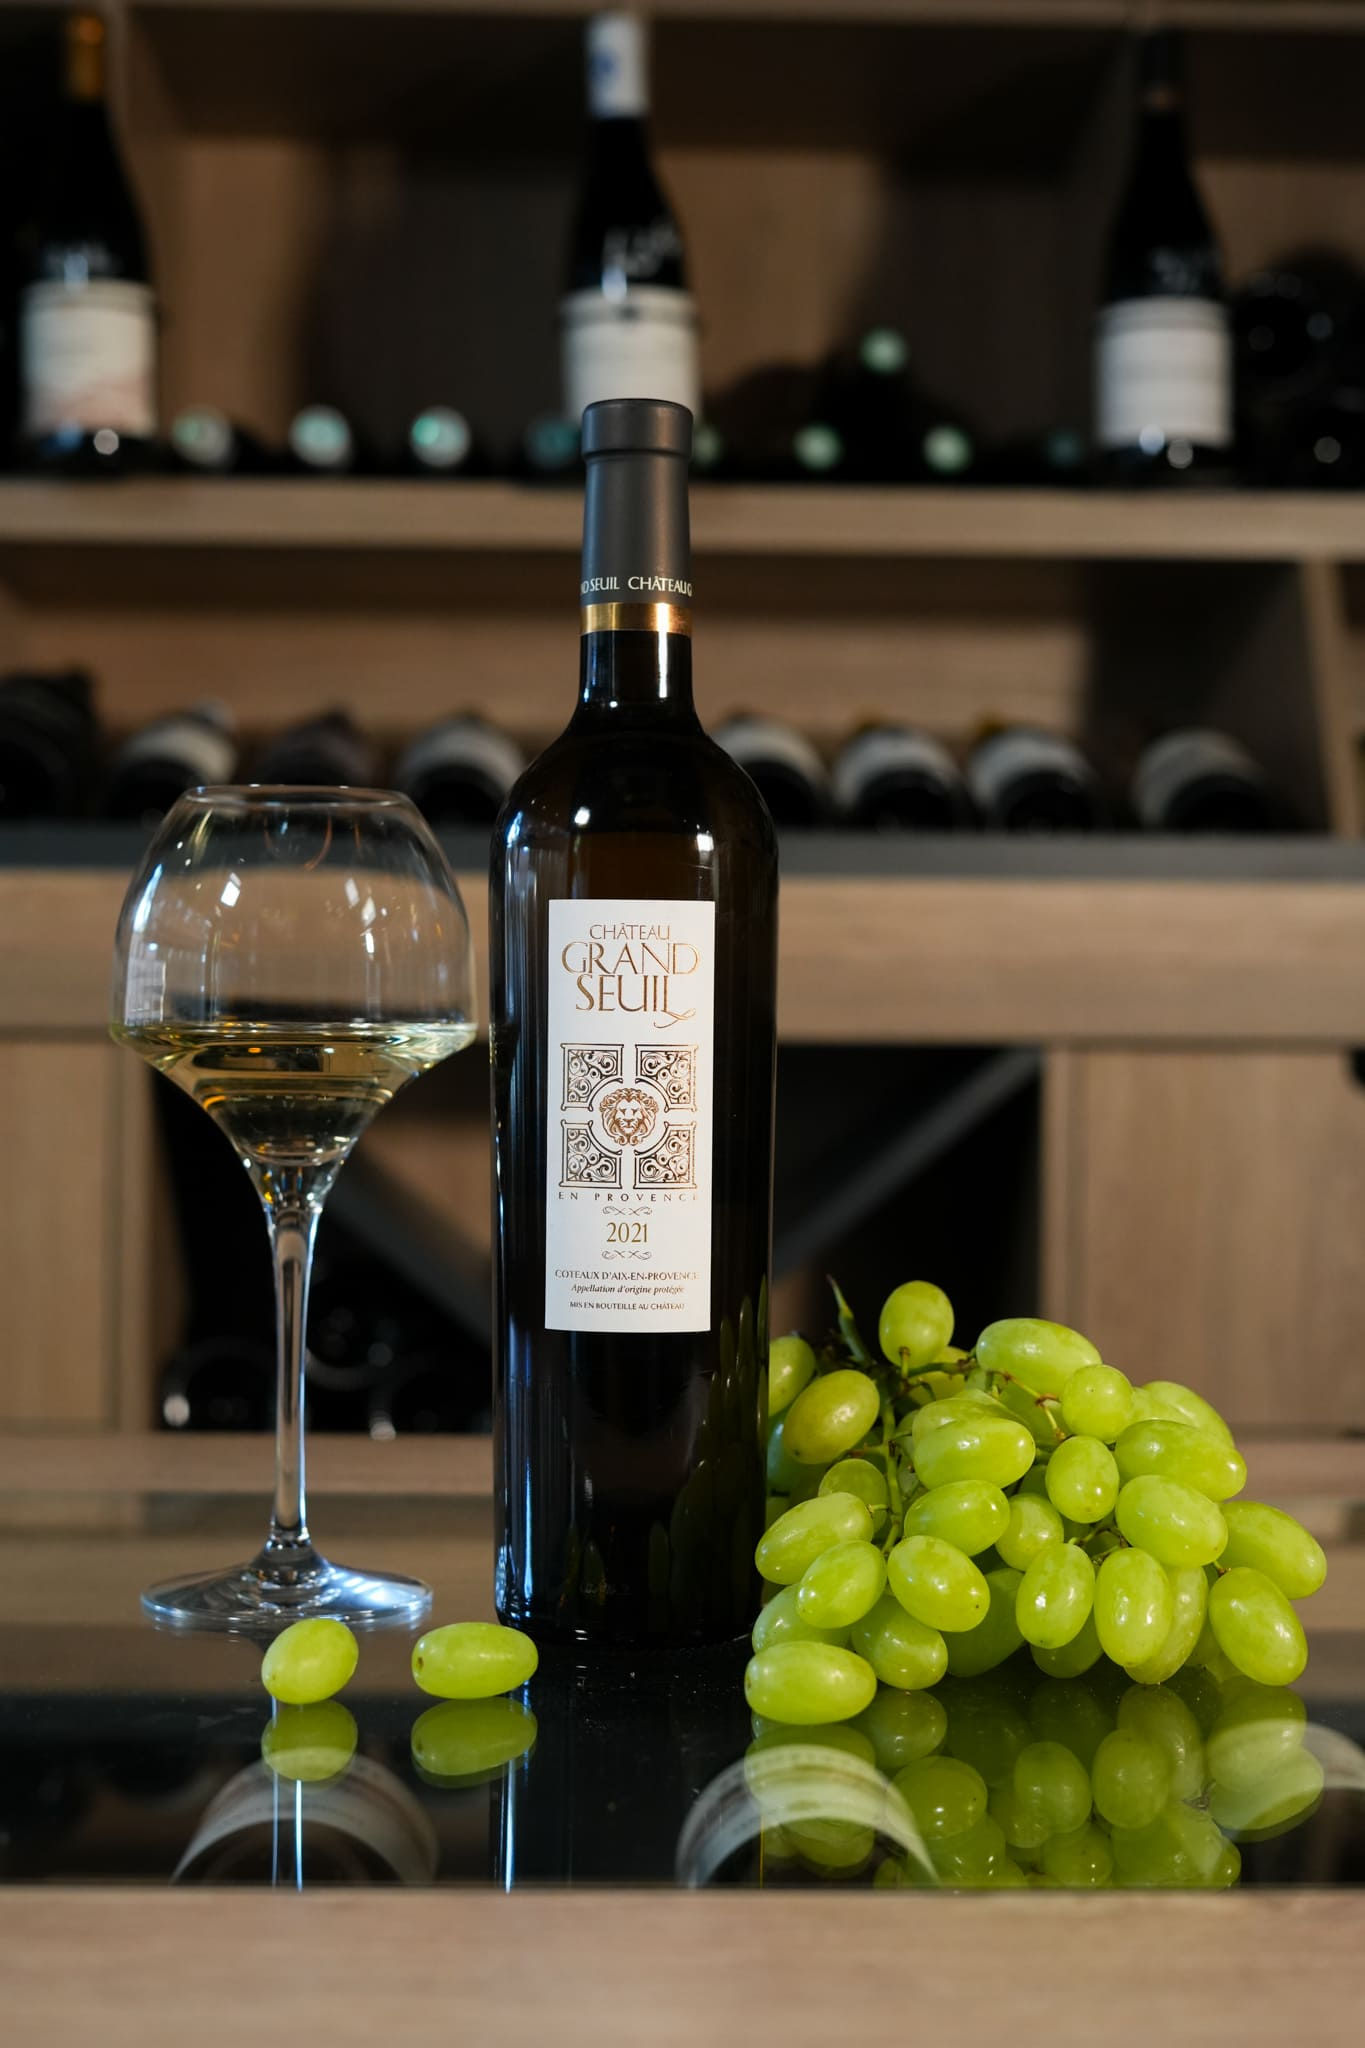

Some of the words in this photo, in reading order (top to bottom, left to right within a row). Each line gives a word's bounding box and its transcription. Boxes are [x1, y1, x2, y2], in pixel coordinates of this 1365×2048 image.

[590, 576, 620, 591] SEUIL
[627, 576, 687, 593] CHÂTEAU
[589, 923, 671, 940] CHÂTEAU
[561, 941, 700, 975] GRAND
[575, 973, 697, 1029] SEUIL
[558, 1191, 579, 1200] EN
[606, 1222, 648, 1243] 2021
[554, 1269, 600, 1280] COTEAUX
[571, 1284, 615, 1294] Appellation
[617, 1285, 651, 1295] d'origine
[569, 1301, 583, 1309] MIS
[584, 1301, 595, 1309] EN
[596, 1302, 637, 1310] BOUTEILLE
